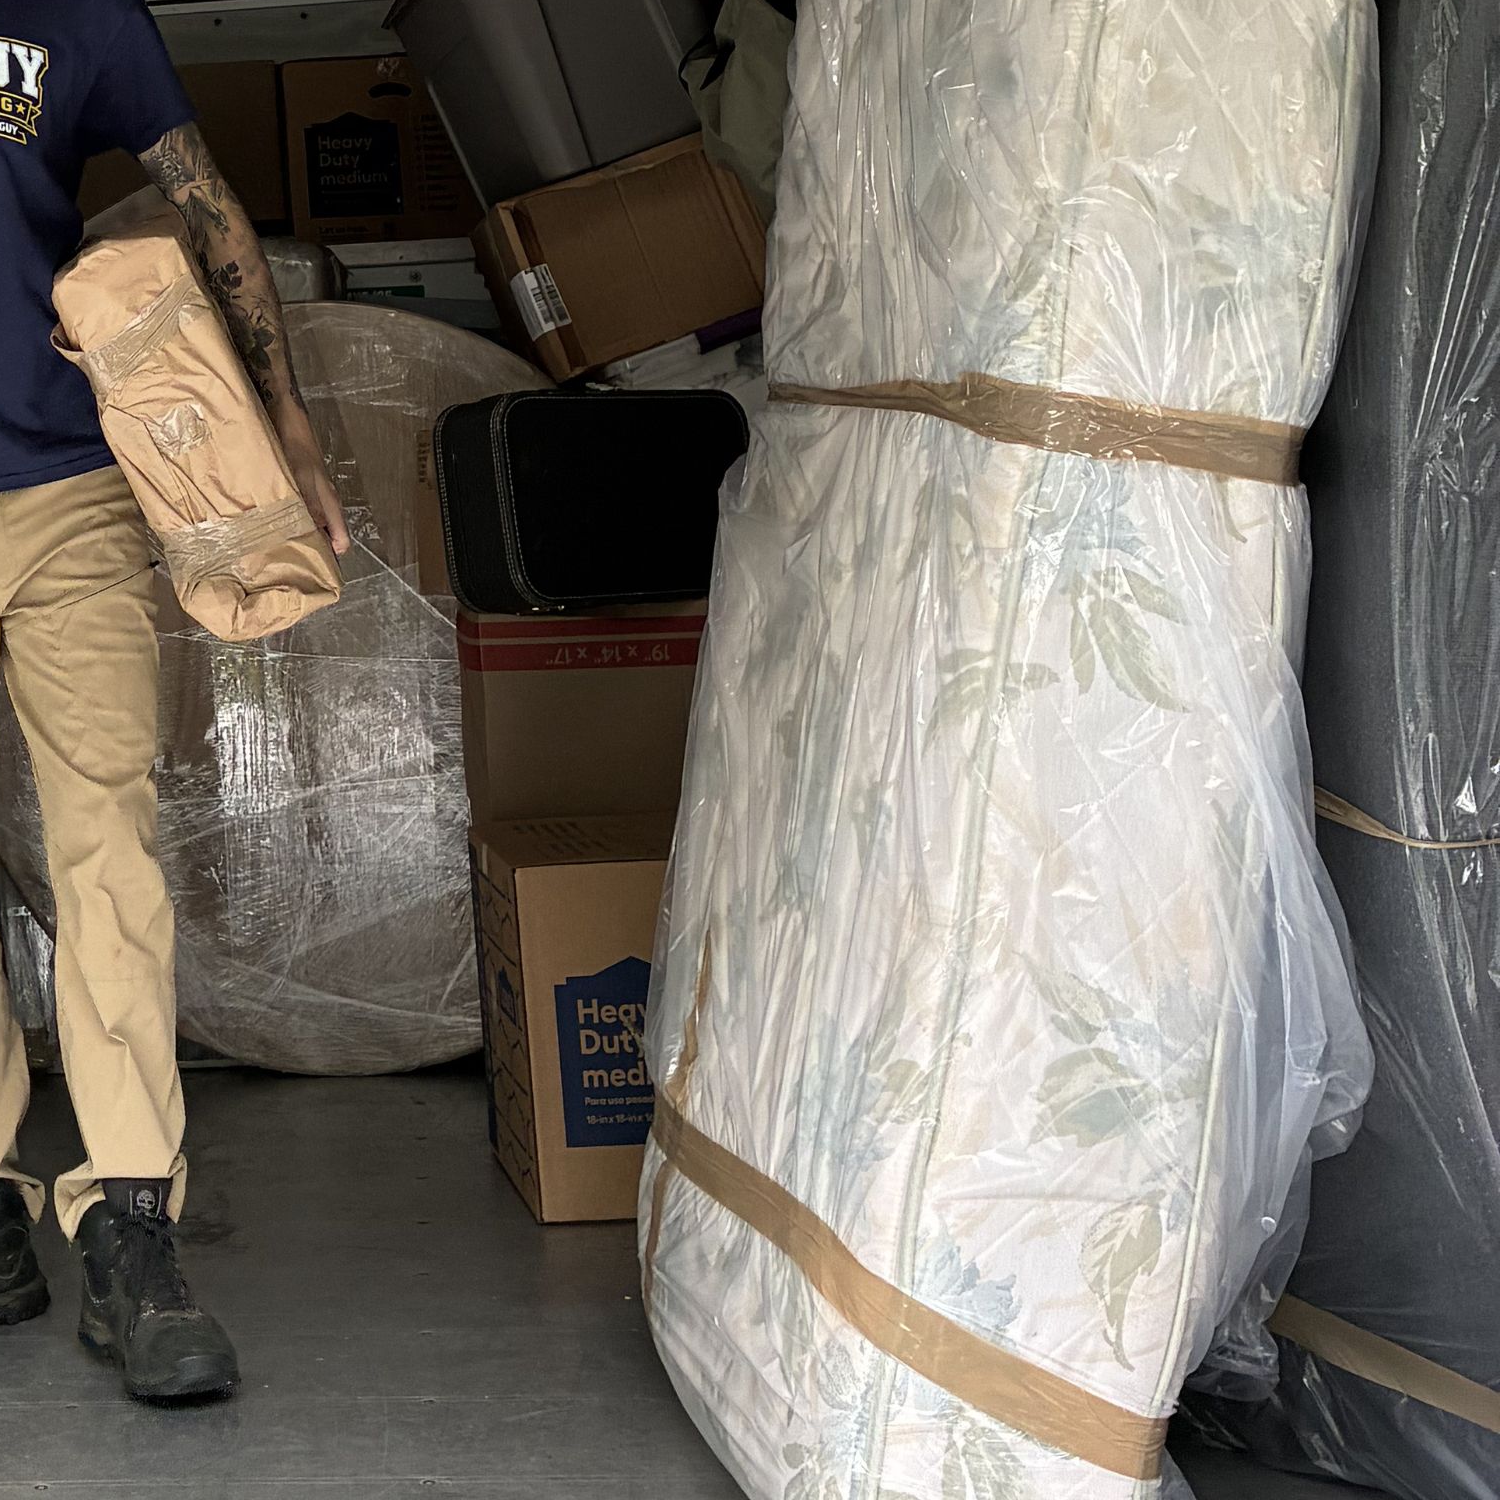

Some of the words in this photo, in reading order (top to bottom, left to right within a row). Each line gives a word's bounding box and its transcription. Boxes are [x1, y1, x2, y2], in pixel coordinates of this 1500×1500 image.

[317, 134, 373, 151] Heavy
[319, 153, 360, 169] Duty
[320, 170, 388, 186] medium
[582, 1061, 653, 1088] med
